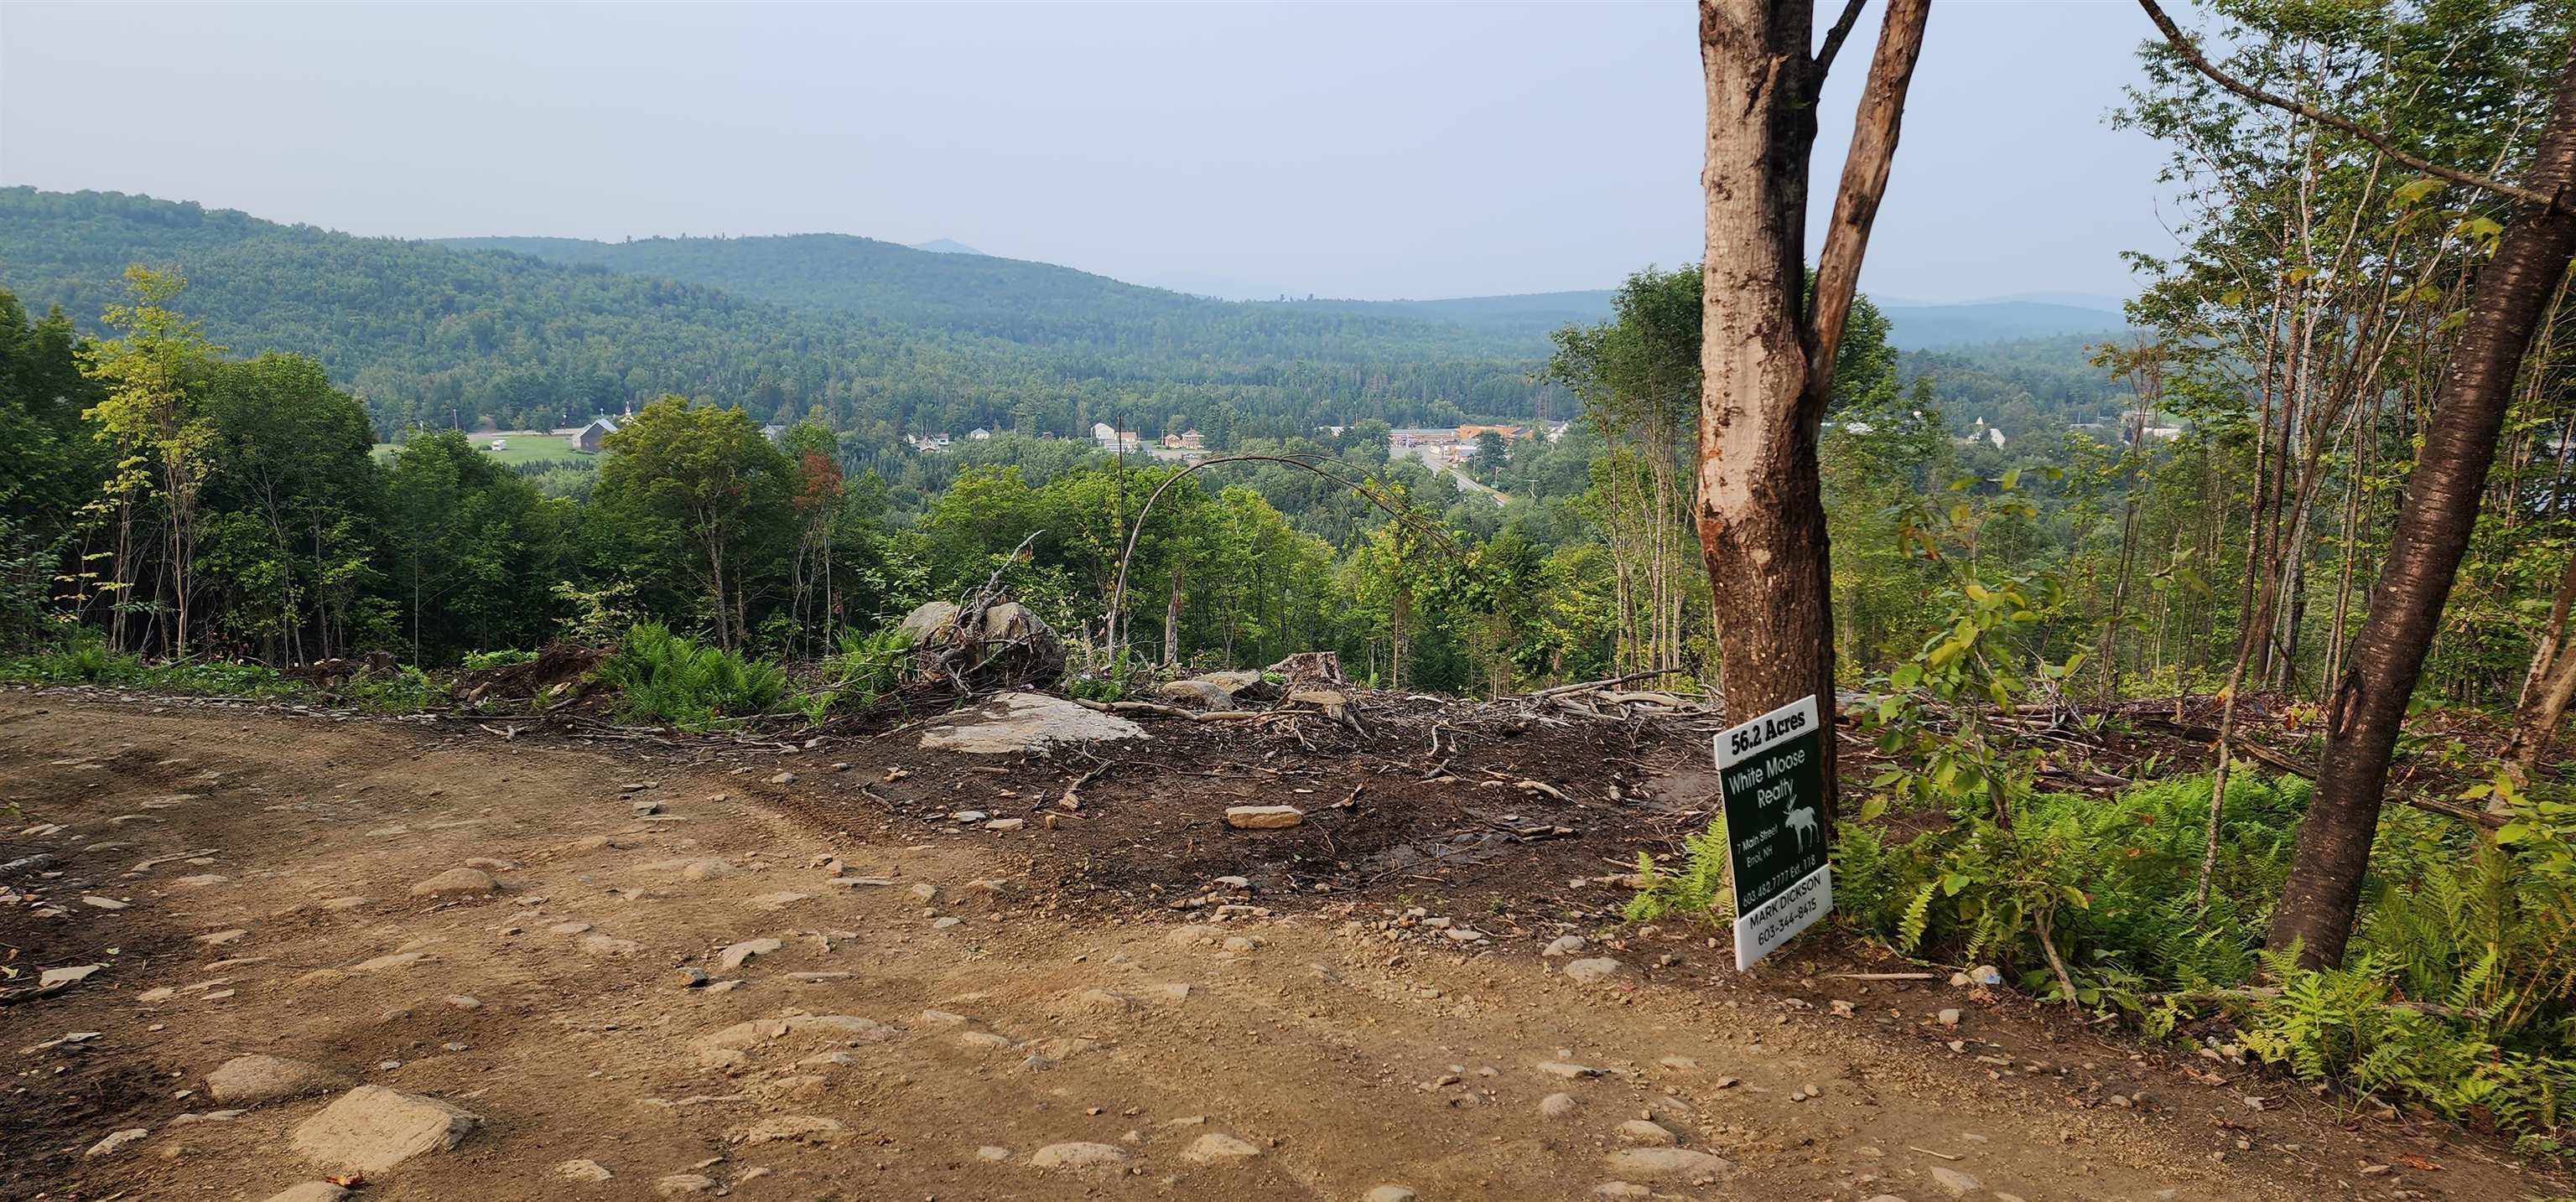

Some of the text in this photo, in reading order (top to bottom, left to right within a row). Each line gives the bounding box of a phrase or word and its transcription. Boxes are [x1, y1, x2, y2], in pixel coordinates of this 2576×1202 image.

[1732, 711, 1805, 755] 56.2 Acres
[1728, 749, 1805, 795] White Moose
[1757, 778, 1794, 809] Realty
[1742, 837, 1760, 852] Main
[1759, 824, 1779, 842] Street
[1763, 845, 1774, 859] NH
[1803, 854, 1816, 871] 118
[1749, 873, 1821, 930] MARK DICKSON
[1758, 898, 1817, 946] 603-344-8415
